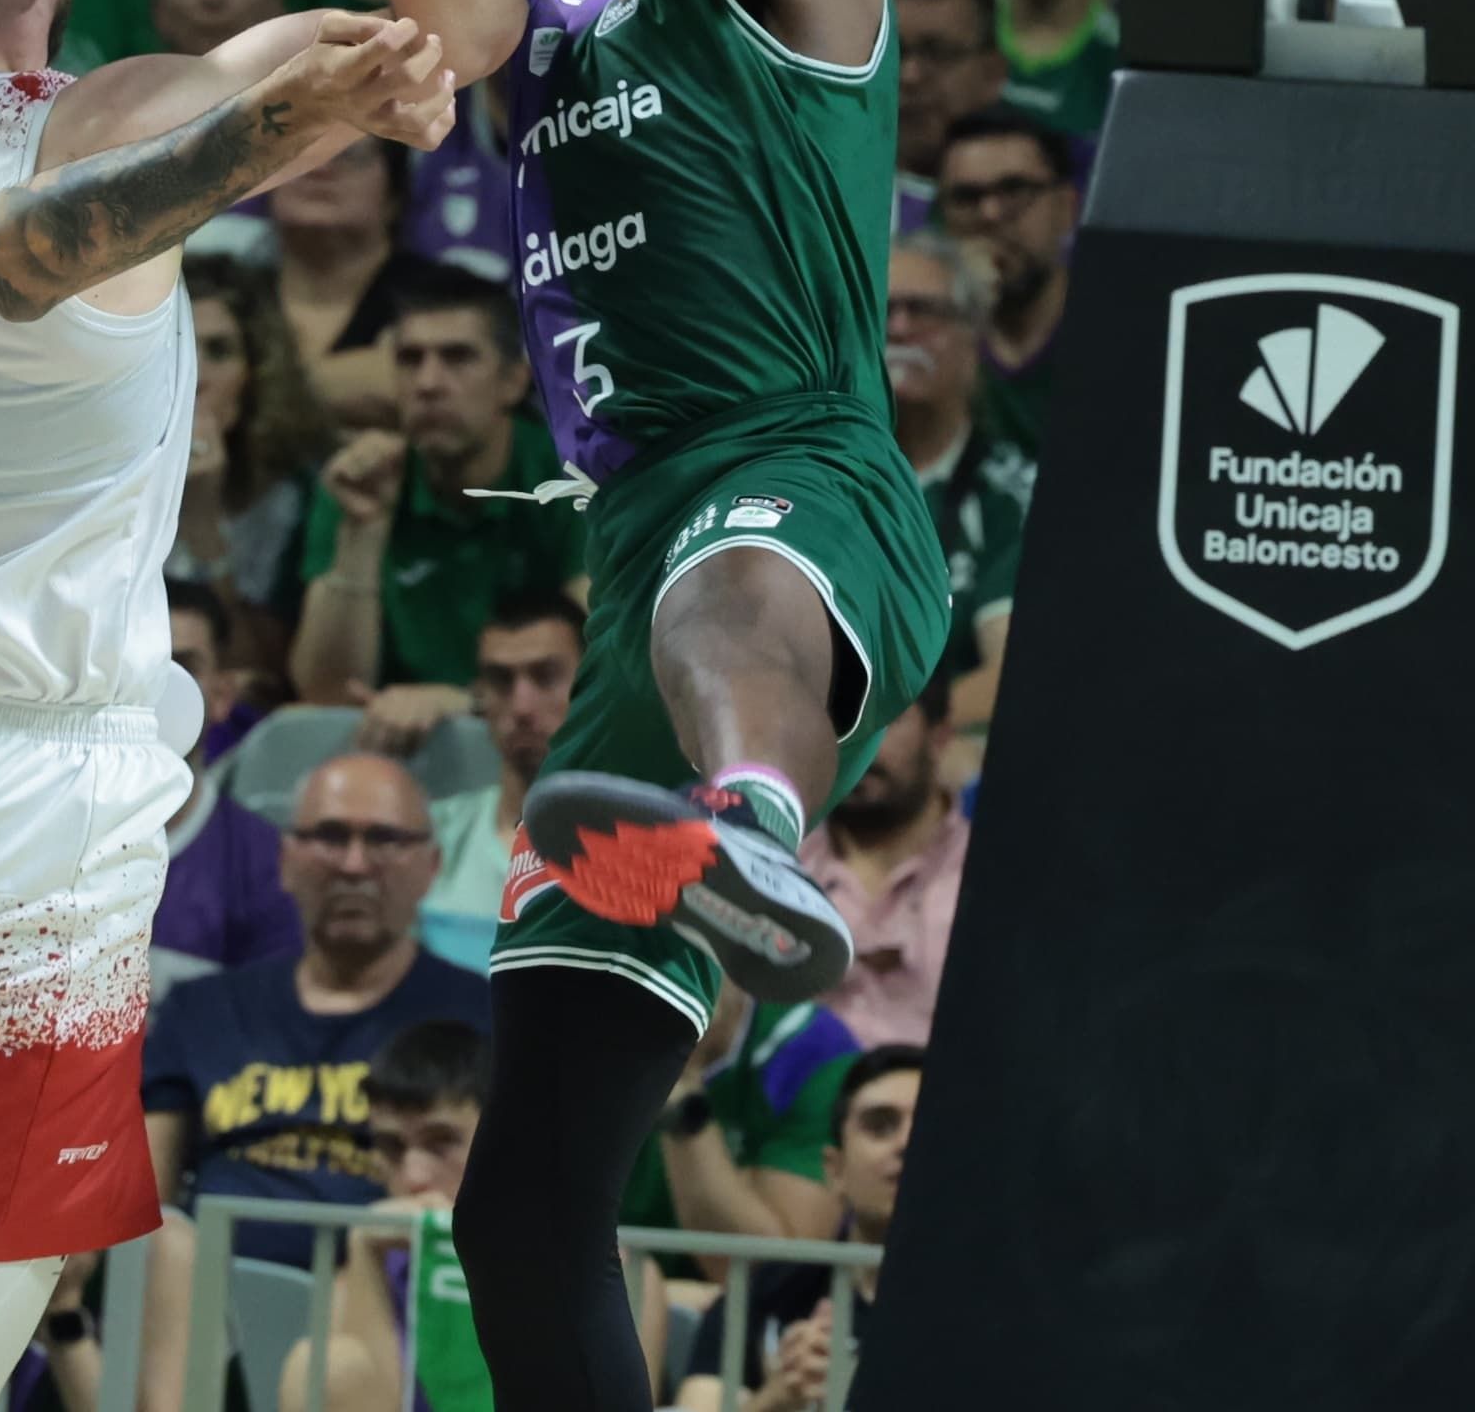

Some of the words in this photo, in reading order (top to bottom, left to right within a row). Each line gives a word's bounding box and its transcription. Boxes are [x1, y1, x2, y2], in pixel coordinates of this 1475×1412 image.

[520, 79, 663, 155] nicaja
[522, 211, 647, 293] álaga
[1209, 446, 1402, 493] Fundación
[1235, 492, 1374, 543] Unicaja
[1204, 529, 1400, 572] Baloncesto
